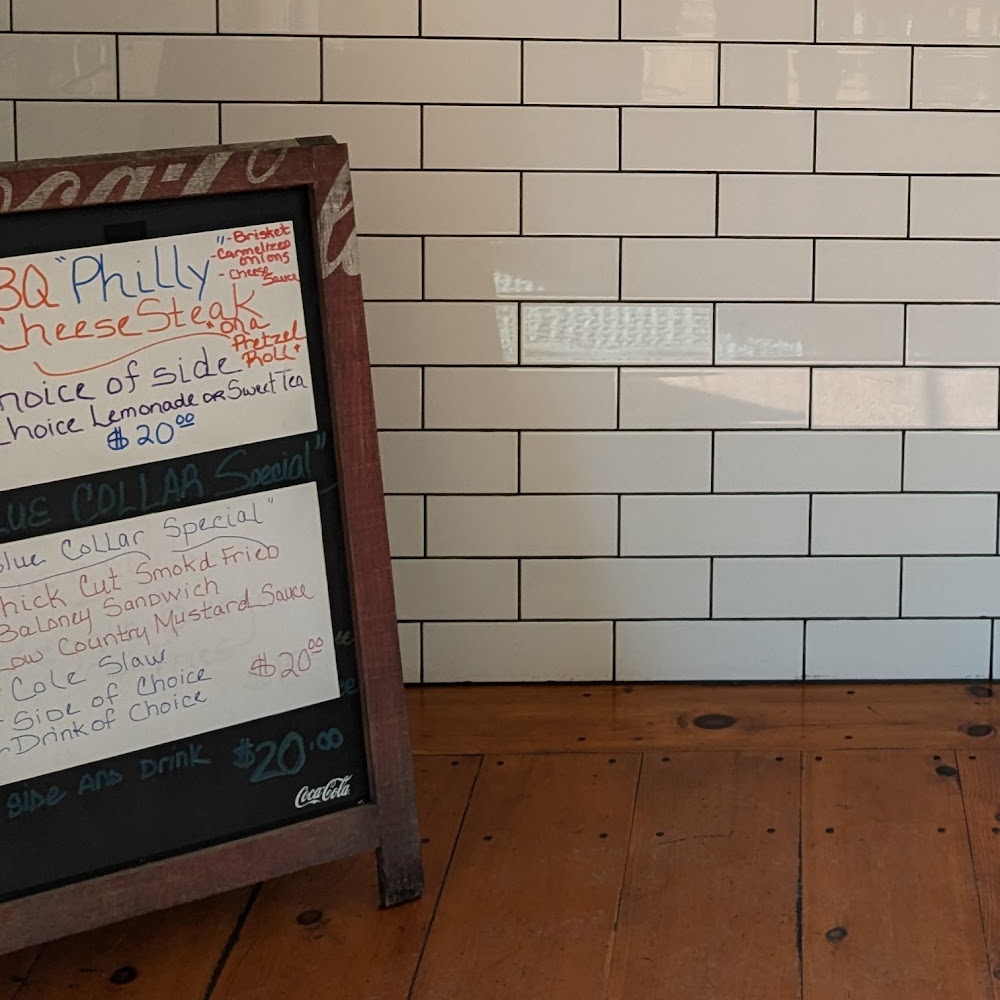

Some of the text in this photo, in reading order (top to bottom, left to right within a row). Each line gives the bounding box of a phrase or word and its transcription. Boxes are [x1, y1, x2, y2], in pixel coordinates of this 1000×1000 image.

[231, 321, 307, 352] Pretzel
[106, 361, 141, 395] of
[92, 394, 199, 429] Lemonade
[79, 571, 122, 597] Cut
[58, 585, 315, 655] Country Mustard Sauce
[99, 651, 169, 676] Slaw
[91, 667, 212, 707] of Choice
